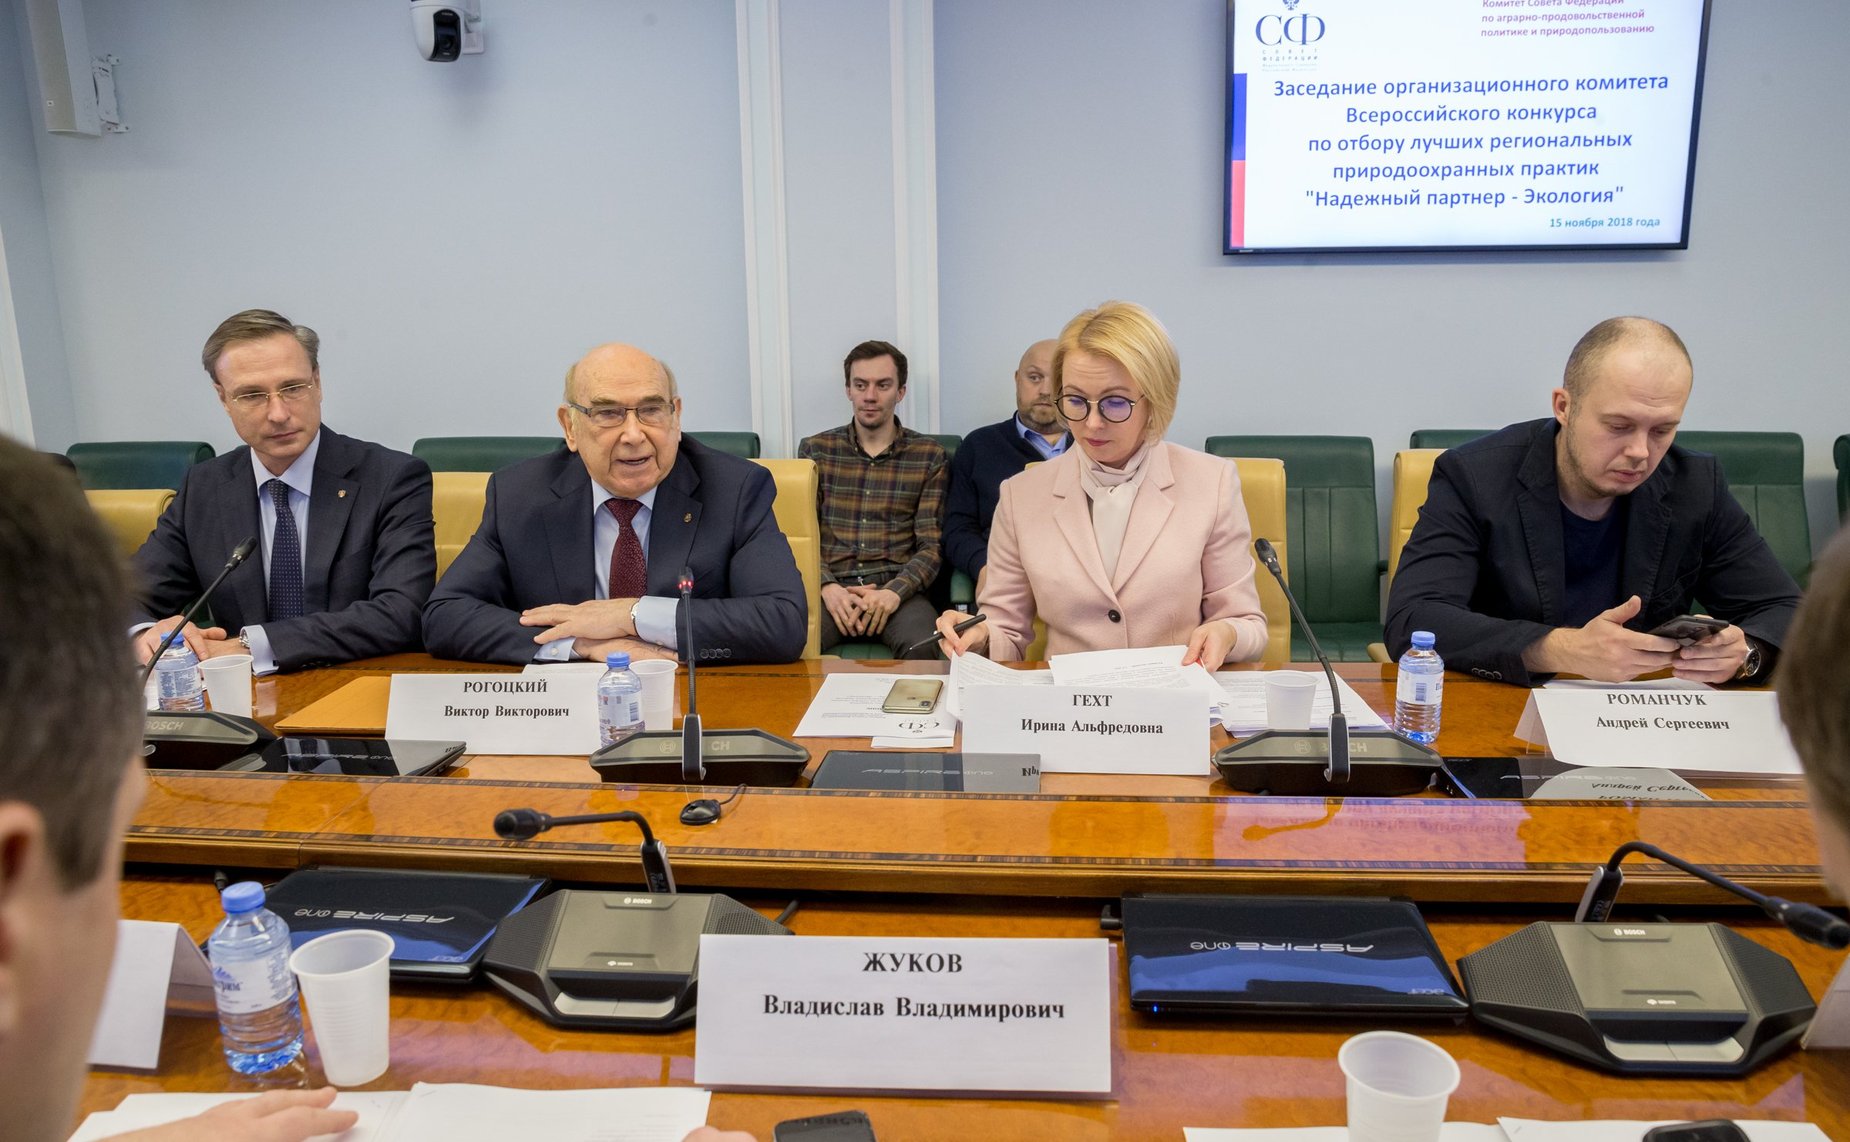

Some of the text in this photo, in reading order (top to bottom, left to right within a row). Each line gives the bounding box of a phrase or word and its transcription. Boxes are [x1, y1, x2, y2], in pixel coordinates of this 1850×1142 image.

[1497, 9, 1645, 23] аграрно-продовольственной
[1255, 13, 1326, 46] СФ
[1480, 29, 1529, 37] политике
[1540, 25, 1655, 37] природопользованию
[1274, 76, 1669, 99] Заседание организационного комитета
[1346, 105, 1598, 126] Всероссийского конкурса
[1308, 134, 1633, 154] по отбору лучших региональных
[1333, 162, 1600, 182] природоохранных практик
[1306, 189, 1421, 210] "Надежный
[1427, 191, 1506, 208] партнер
[1523, 186, 1624, 204] Экология"
[1549, 217, 1661, 229] 15 ноября 2018 года
[463, 678, 548, 695] РОГОЦКИЙ
[1072, 694, 1113, 707] ГЕХТ
[1606, 693, 1708, 706] РОМАНЧУК
[443, 705, 570, 719] Виктор Викторович
[1021, 718, 1164, 735] Ирина Альфредовна
[1596, 716, 1730, 731] Андрей Сергеевич
[333, 910, 455, 925] ASPIRE
[1235, 942, 1375, 953] ASPIRE
[862, 952, 963, 973] ЖУКОВ
[762, 994, 1065, 1023] Владислав Владимирович
